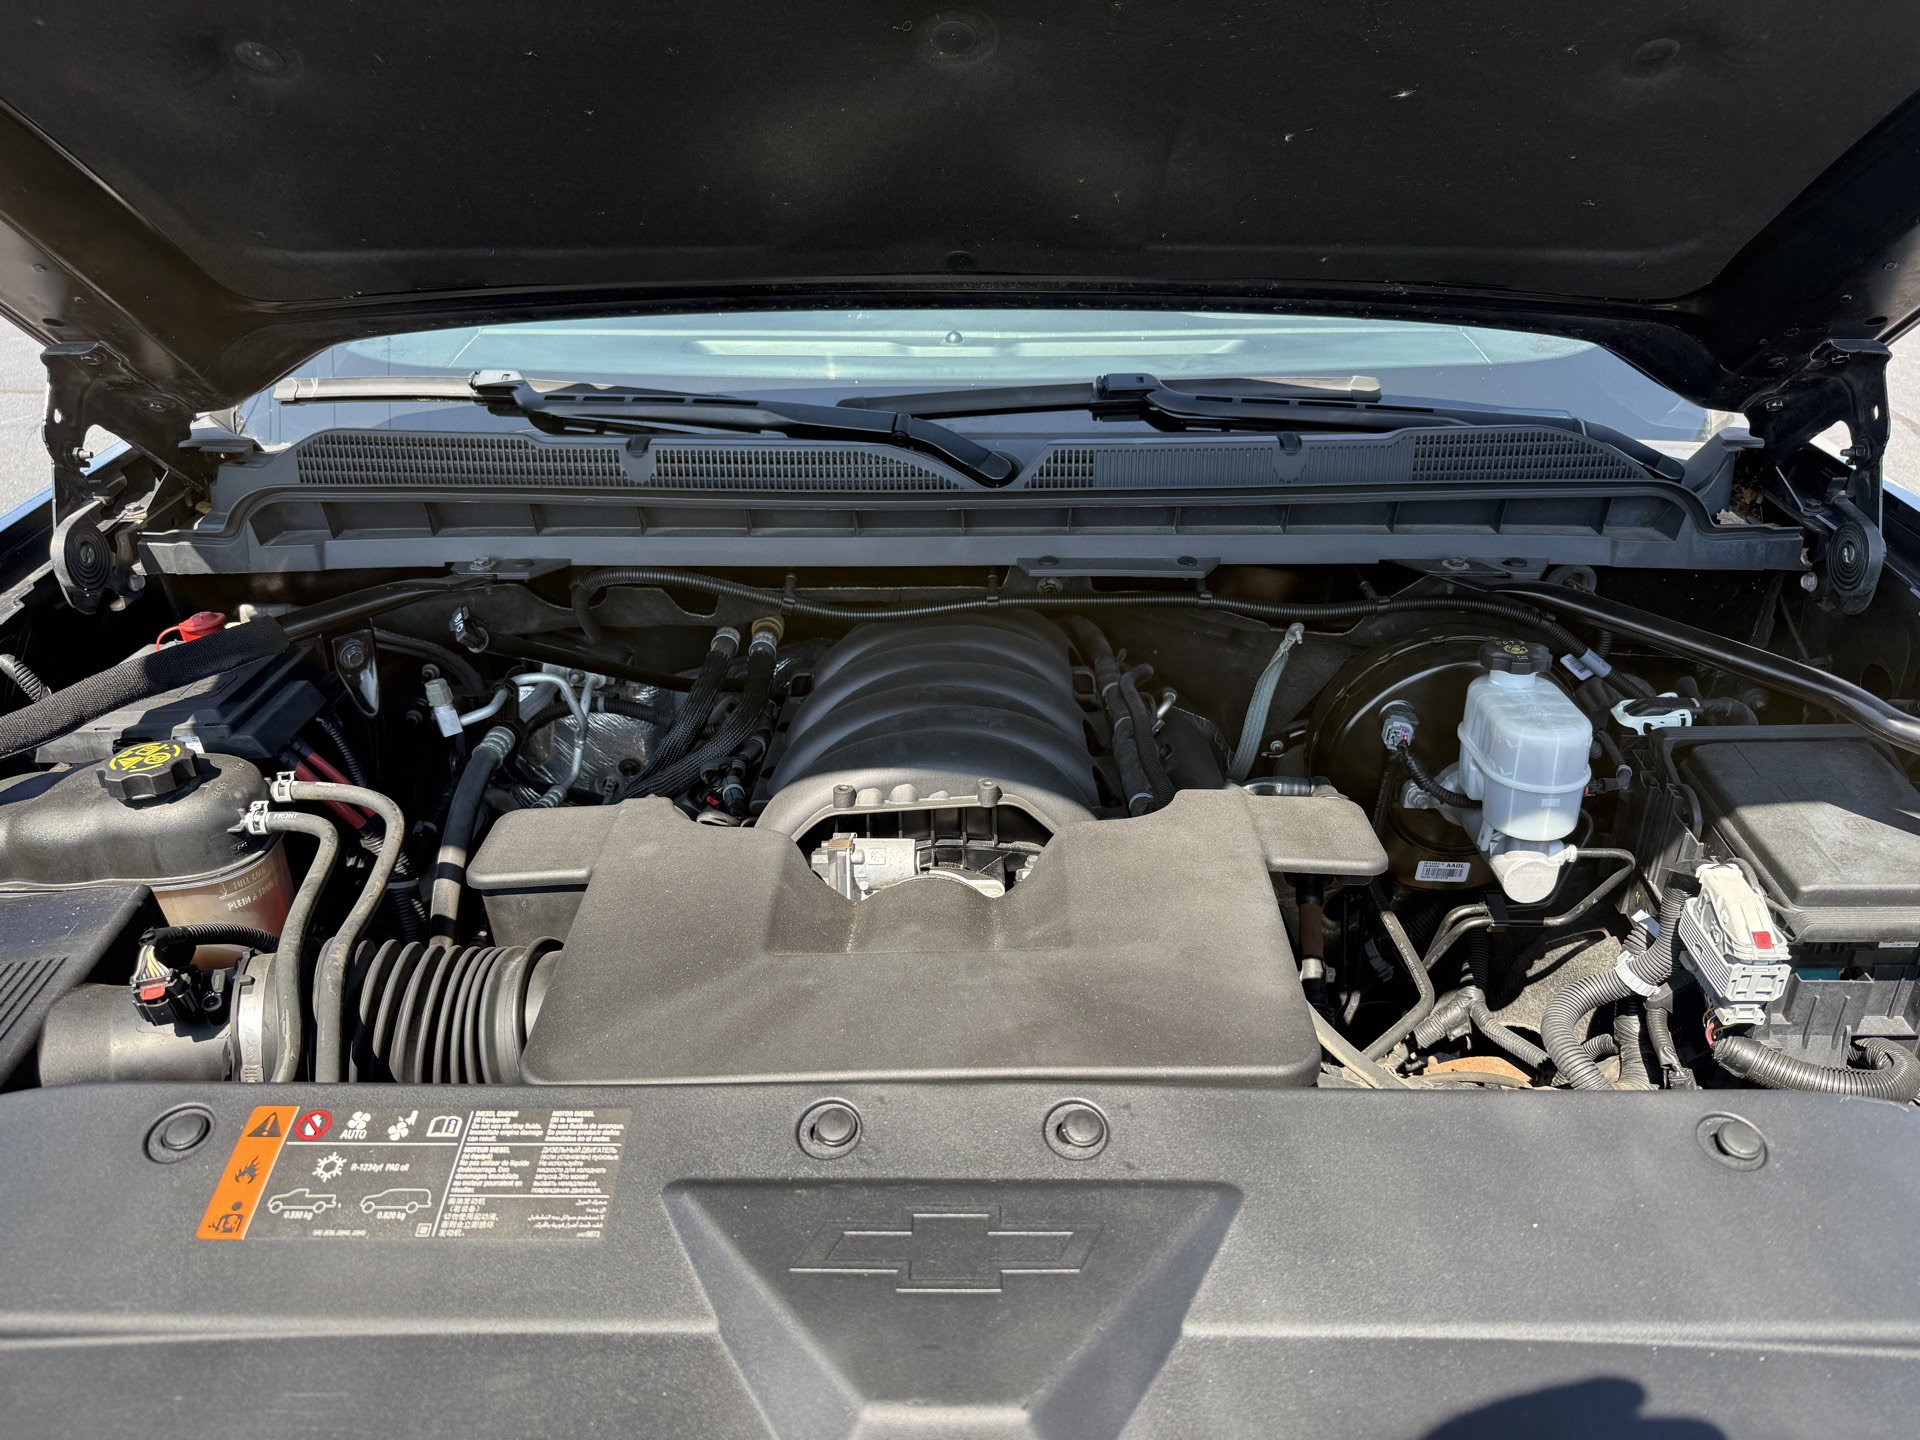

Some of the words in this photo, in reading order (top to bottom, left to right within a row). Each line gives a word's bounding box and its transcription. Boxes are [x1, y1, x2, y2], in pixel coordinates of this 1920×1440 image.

[273, 812, 299, 820] FRONT
[227, 895, 252, 911] PLEIN
[340, 1129, 367, 1139] AUTO
[385, 1163, 399, 1171] PAG
[400, 1163, 410, 1171] oil
[304, 1211, 314, 1221] kg
[397, 1211, 406, 1221] kg
